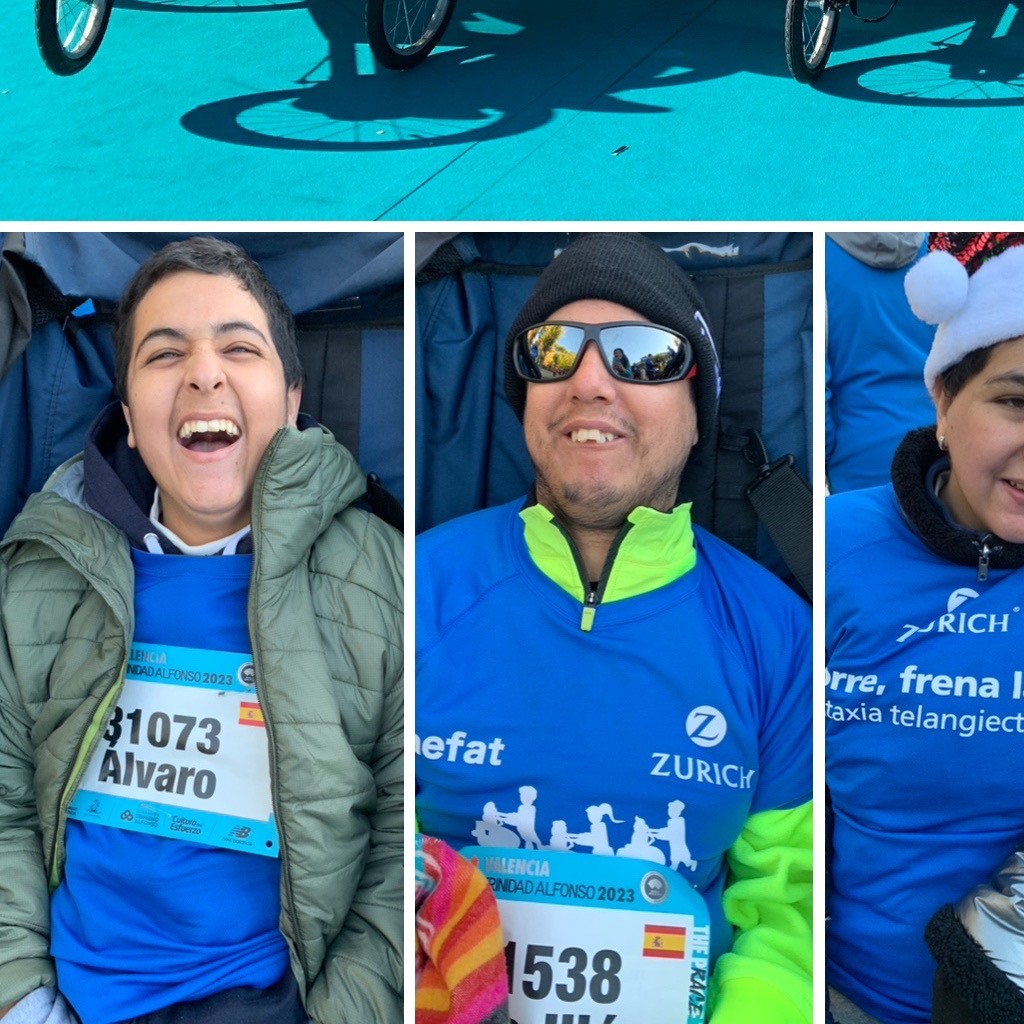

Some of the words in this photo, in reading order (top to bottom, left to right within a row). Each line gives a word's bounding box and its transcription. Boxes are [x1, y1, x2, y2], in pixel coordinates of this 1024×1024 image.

[202, 672, 233, 686] 2023
[900, 664, 999, 699] frena
[103, 705, 222, 756] 31073
[649, 751, 756, 790] ZURICH
[535, 880, 595, 900] ALFONSO
[596, 885, 635, 903] 2023
